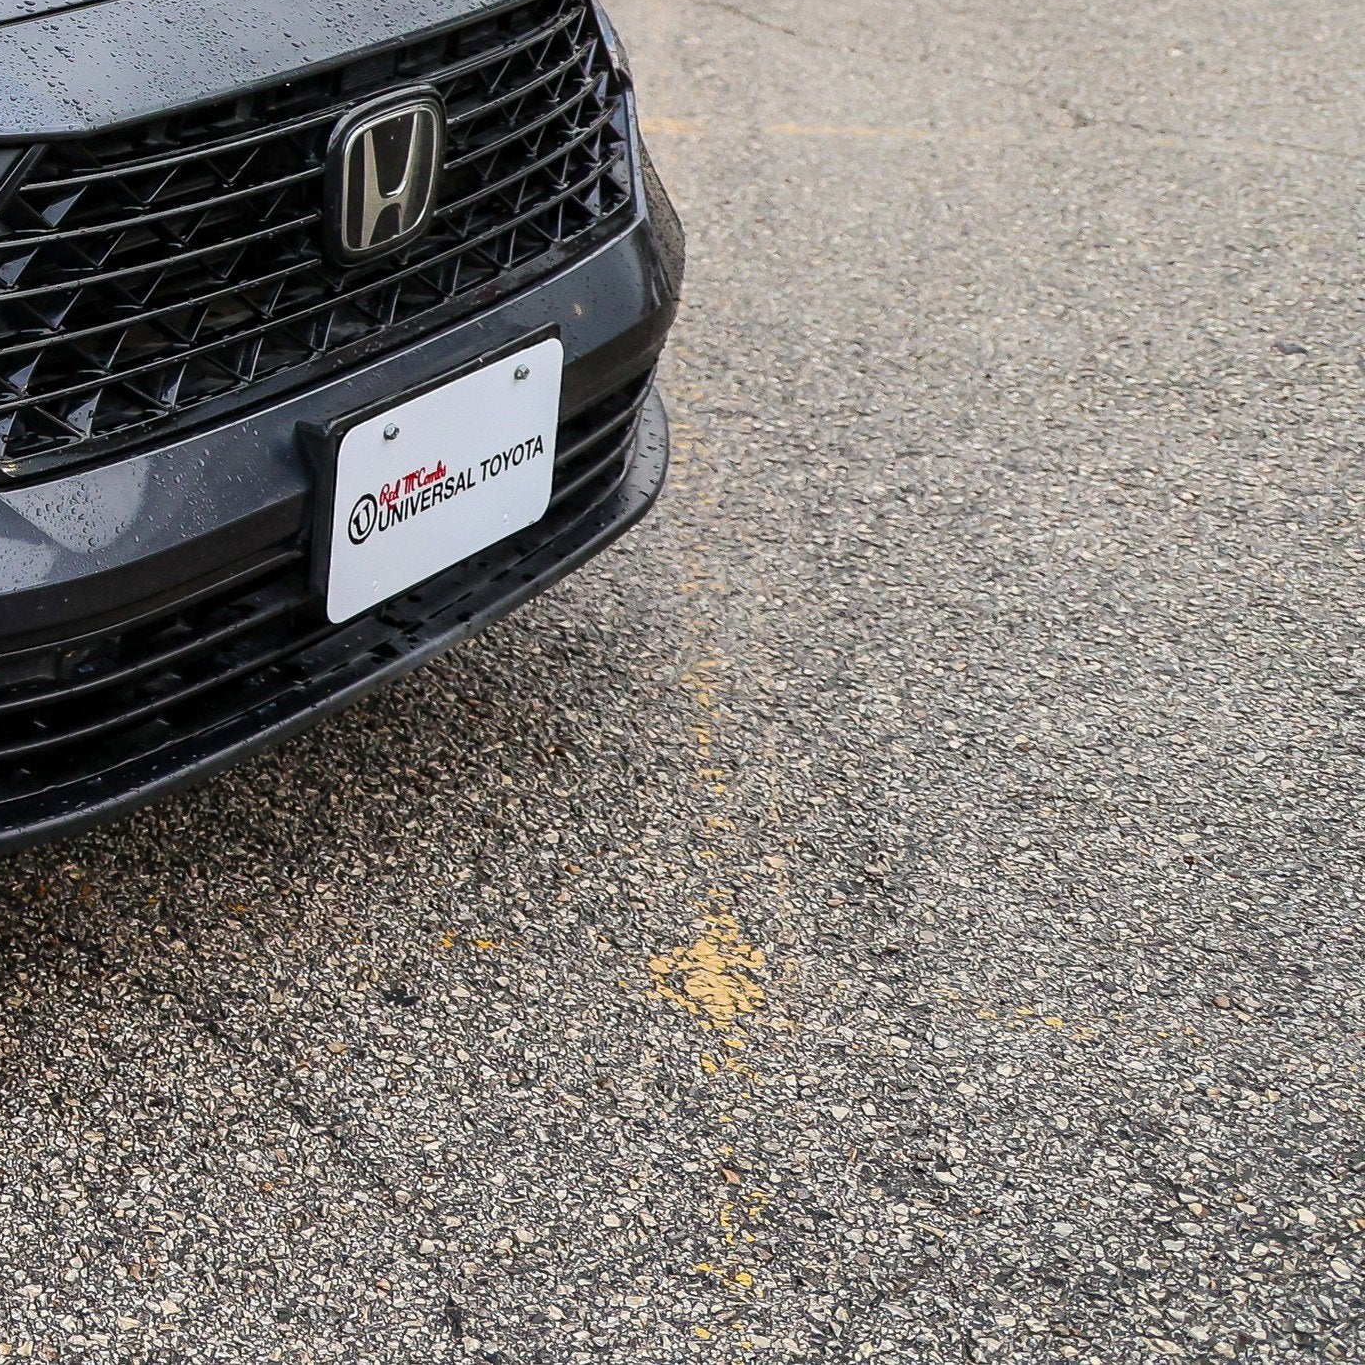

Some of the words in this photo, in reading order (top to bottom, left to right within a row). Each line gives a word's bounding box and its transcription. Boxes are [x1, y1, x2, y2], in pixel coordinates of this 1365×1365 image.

[377, 467, 477, 532] UNIVERSAL
[480, 435, 544, 482] TOYOTA
[379, 481, 400, 510] Red
